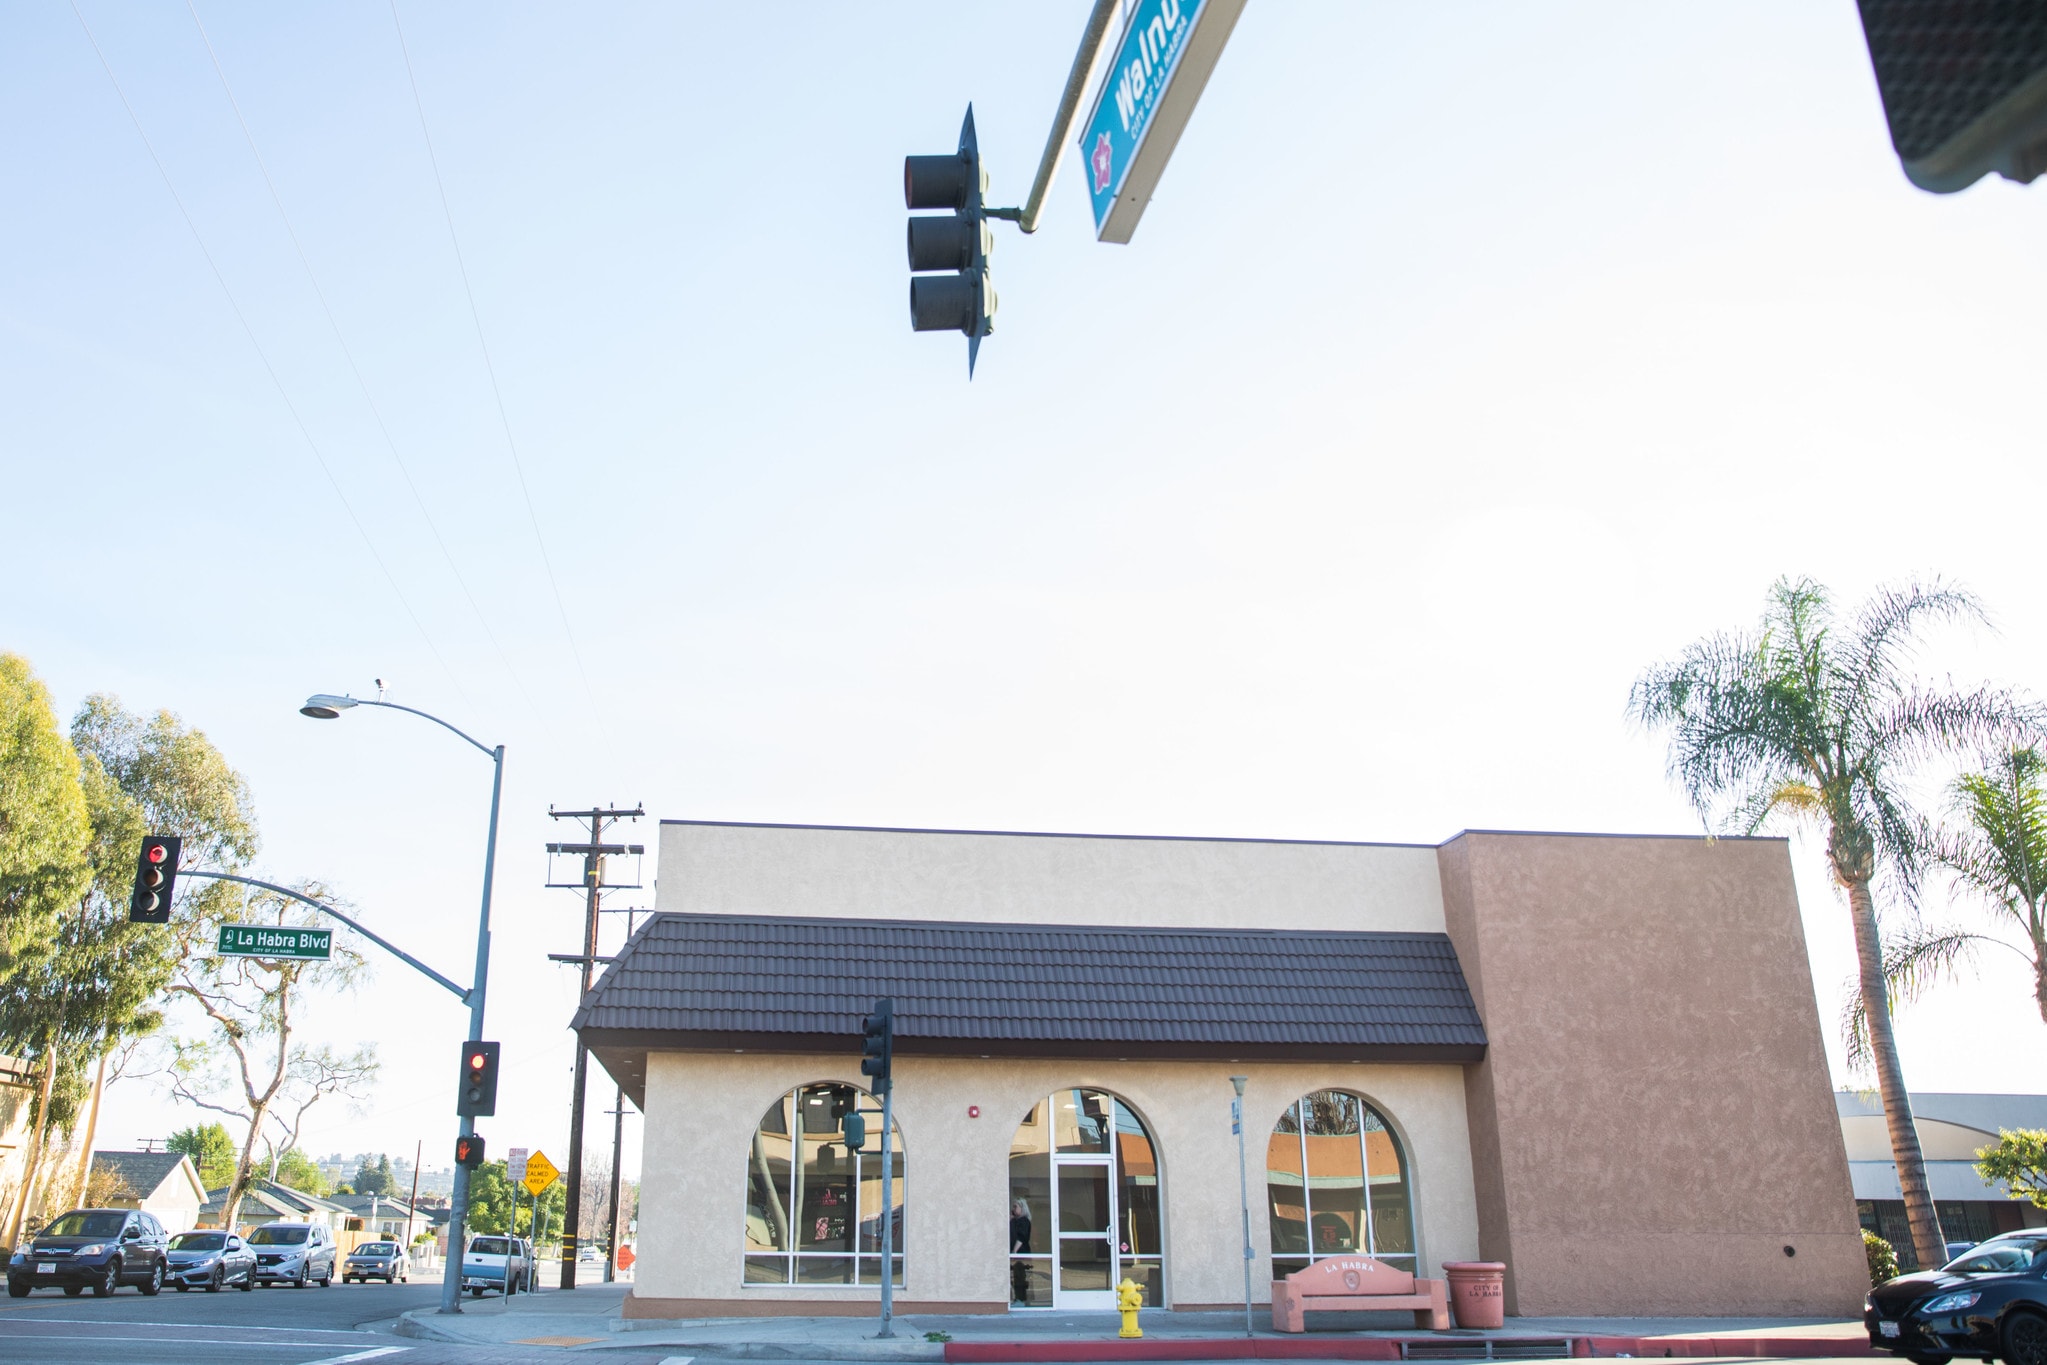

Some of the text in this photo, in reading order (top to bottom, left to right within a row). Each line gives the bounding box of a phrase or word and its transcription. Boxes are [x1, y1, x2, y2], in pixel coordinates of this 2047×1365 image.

[1115, 0, 1183, 132] Walnu
[1131, 14, 1188, 140] CITY OF LA HABRA
[238, 931, 329, 949] La Habra Blvd
[1325, 1261, 1374, 1273] LA HABRA
